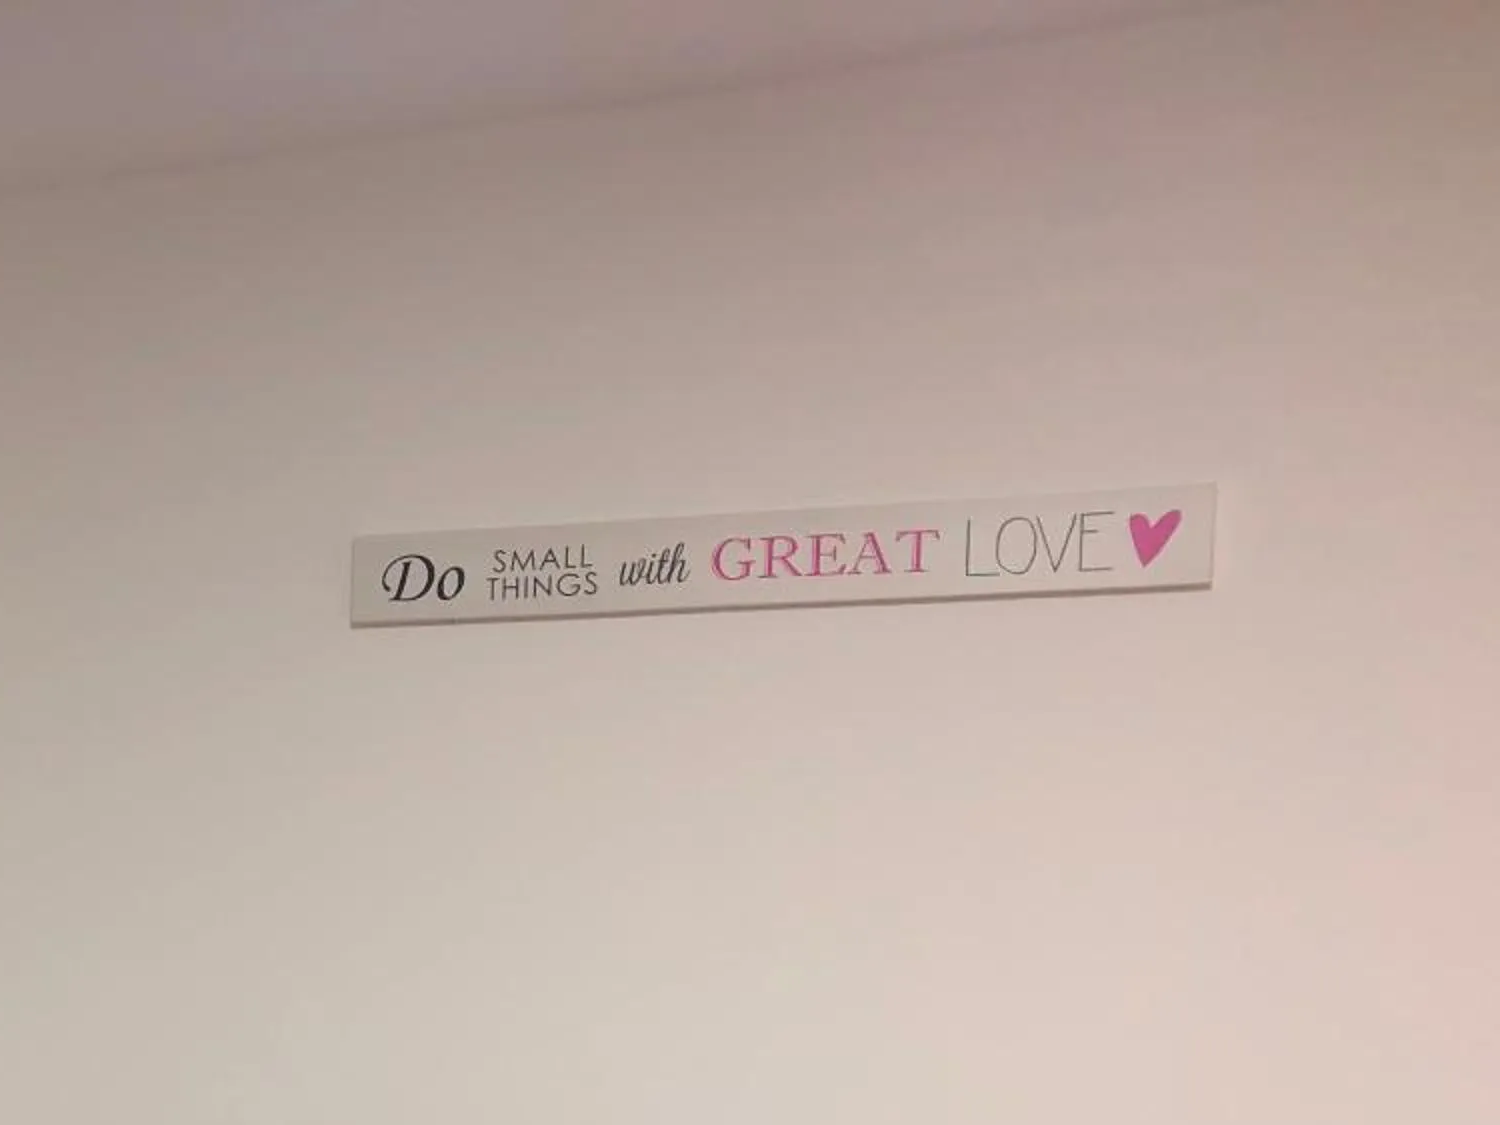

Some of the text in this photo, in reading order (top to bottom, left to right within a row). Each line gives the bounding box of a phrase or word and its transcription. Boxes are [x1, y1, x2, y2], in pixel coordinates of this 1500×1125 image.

[382, 509, 1116, 603] Do SMALL THINGS with GREAT LOVE
